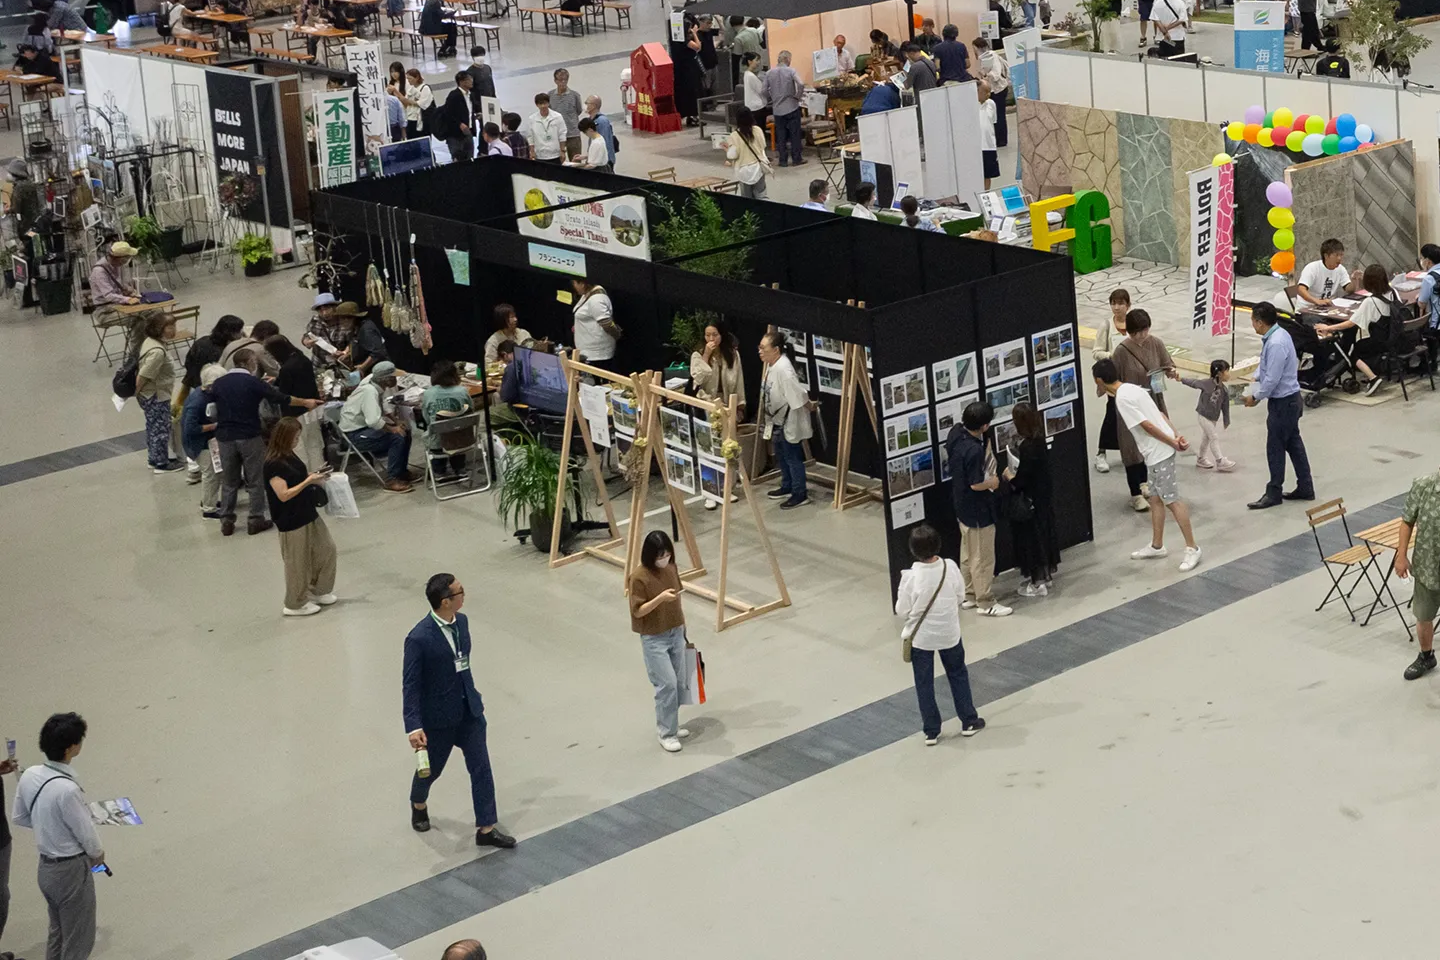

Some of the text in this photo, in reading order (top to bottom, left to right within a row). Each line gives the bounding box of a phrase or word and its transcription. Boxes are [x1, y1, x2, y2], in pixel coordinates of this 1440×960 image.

[214, 108, 242, 128] BELLS
[323, 96, 353, 167] 不動産
[216, 132, 246, 152] MORE
[219, 156, 251, 176] JAPAN
[560, 225, 585, 239] Special
[586, 230, 609, 244] Thanks
